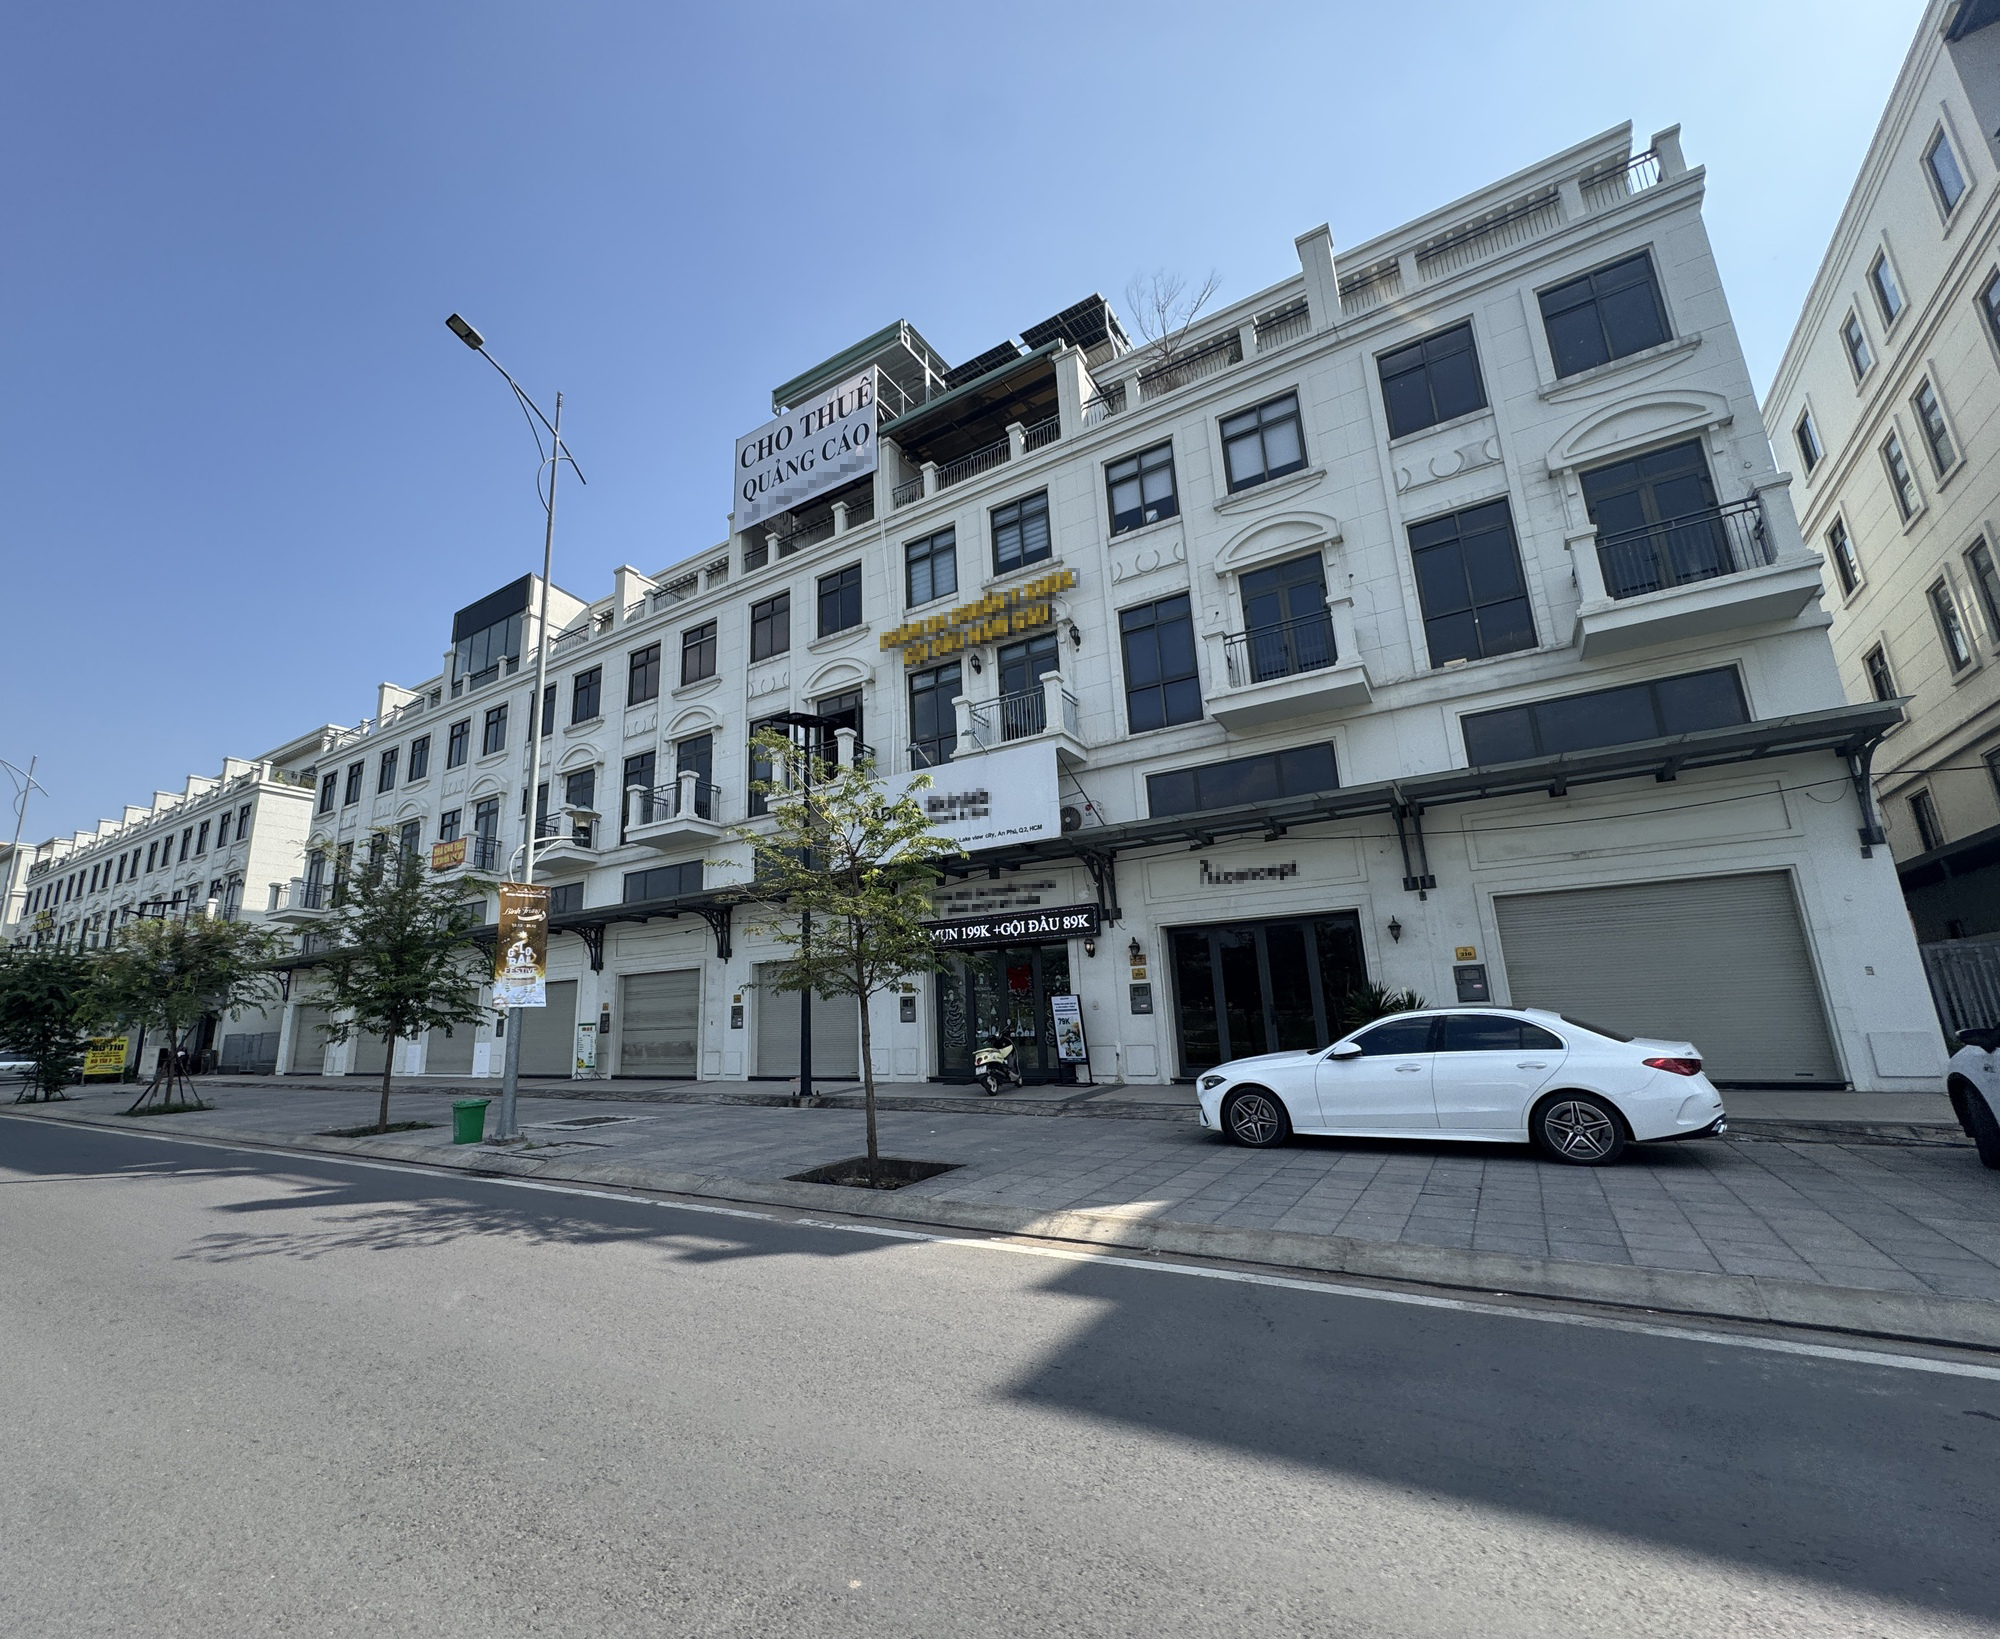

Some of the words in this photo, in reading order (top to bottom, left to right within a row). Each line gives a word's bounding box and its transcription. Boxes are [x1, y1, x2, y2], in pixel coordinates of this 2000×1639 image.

[741, 425, 793, 469] CHO
[799, 376, 873, 439] THUÊ
[742, 449, 816, 503] QUẢNG
[822, 422, 870, 462] CÁO
[1029, 824, 1043, 832] HCM
[929, 927, 958, 944] MỤN
[961, 925, 991, 939] 199K
[992, 919, 1026, 937] +GỘI
[1028, 915, 1060, 932] ĐẦU
[1062, 913, 1090, 930] 89K
[1057, 1017, 1071, 1026] 79K
